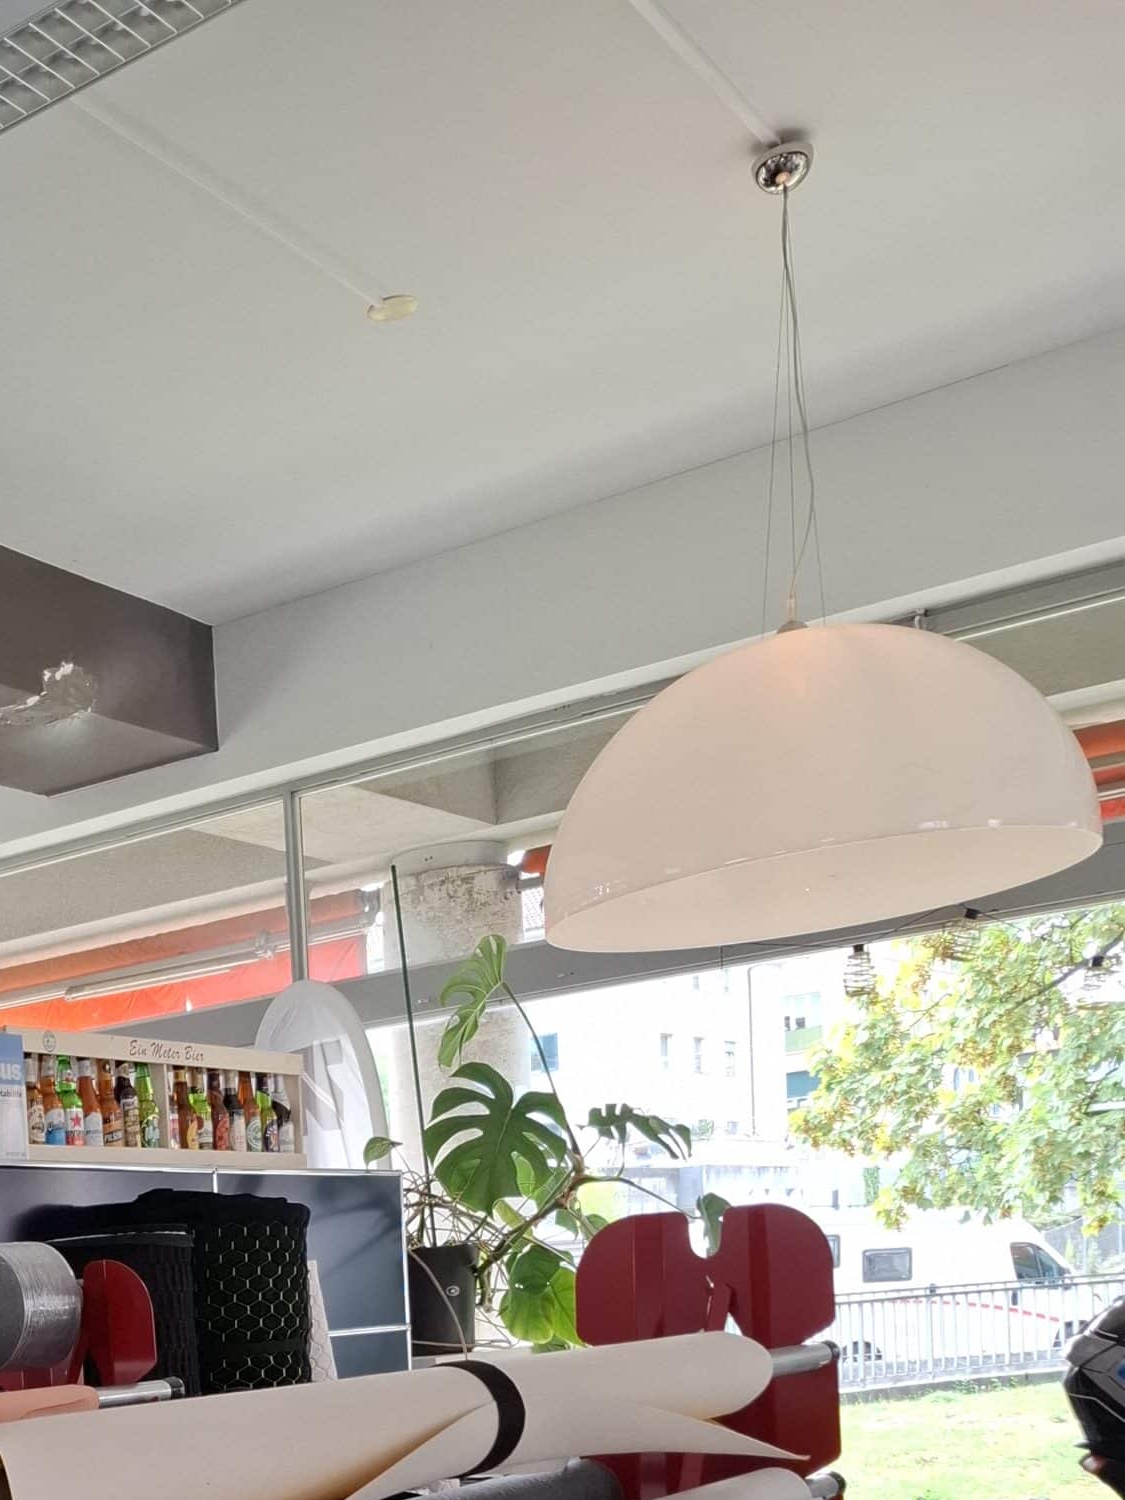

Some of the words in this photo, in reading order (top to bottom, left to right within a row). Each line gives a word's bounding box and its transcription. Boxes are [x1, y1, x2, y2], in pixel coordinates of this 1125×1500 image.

[129, 1040, 147, 1056] Ein
[151, 1042, 180, 1060] Meter
[185, 1046, 204, 1062] Bier
